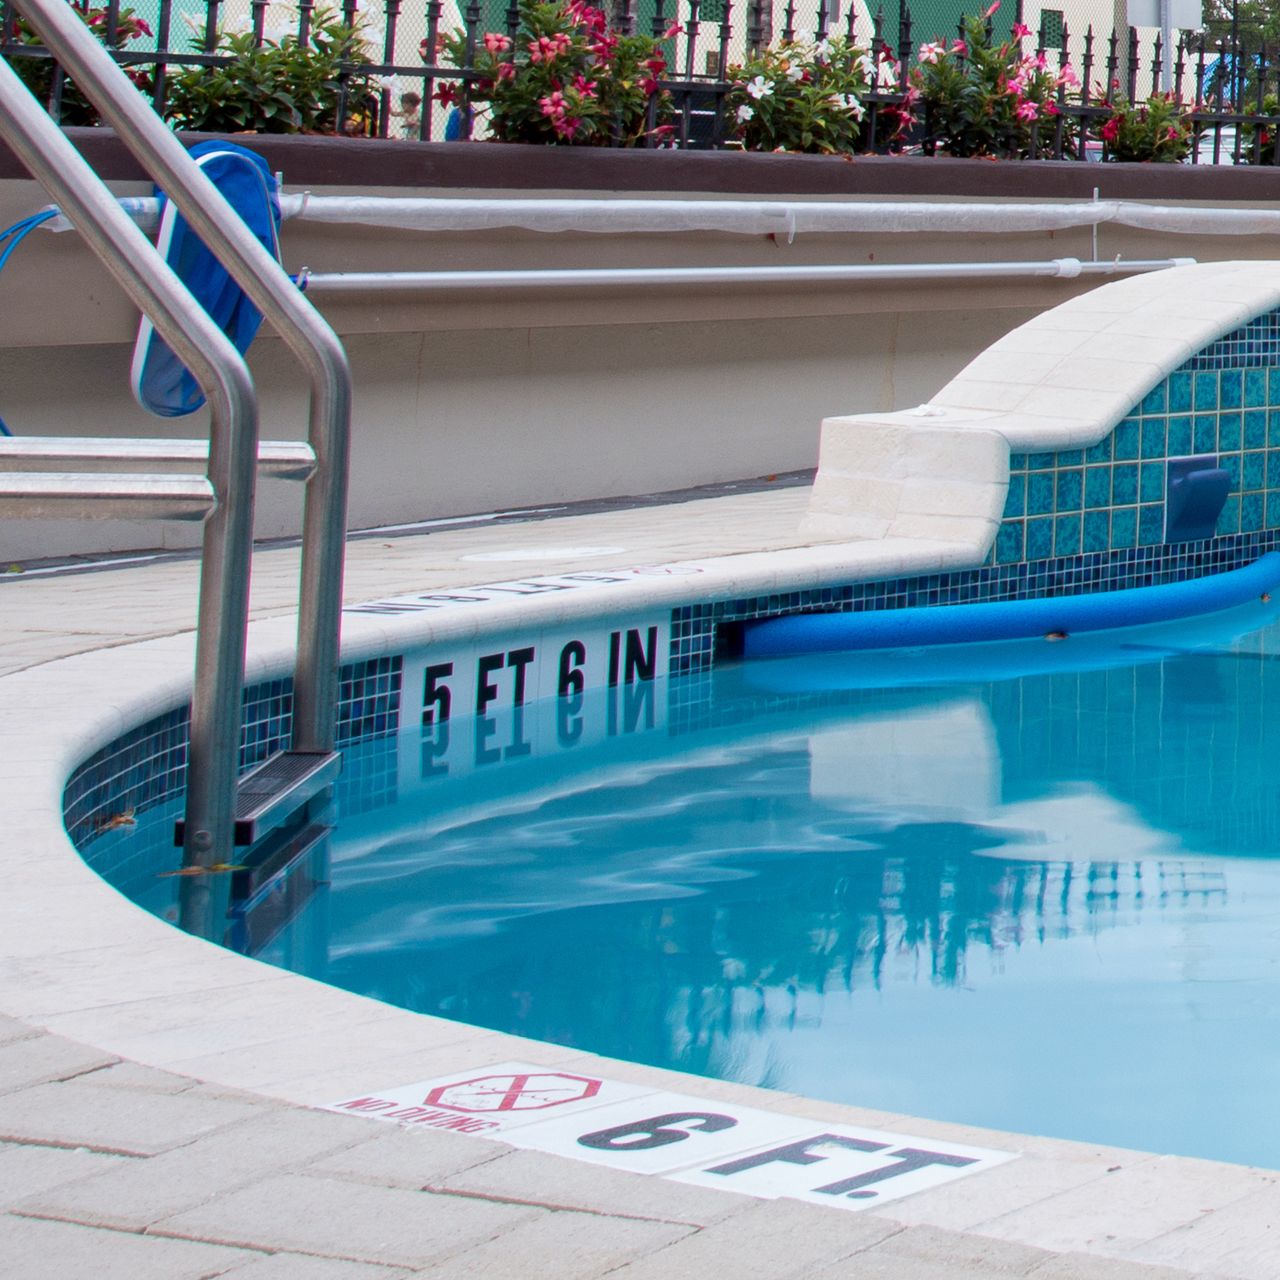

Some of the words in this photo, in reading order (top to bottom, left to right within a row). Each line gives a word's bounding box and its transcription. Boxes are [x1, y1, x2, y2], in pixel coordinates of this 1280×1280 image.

[421, 662, 453, 725] 5
[557, 640, 586, 698] 6
[607, 626, 658, 688] IN
[336, 1097, 399, 1112] NO
[383, 1106, 501, 1134] DIVING
[575, 1111, 740, 1151] 6
